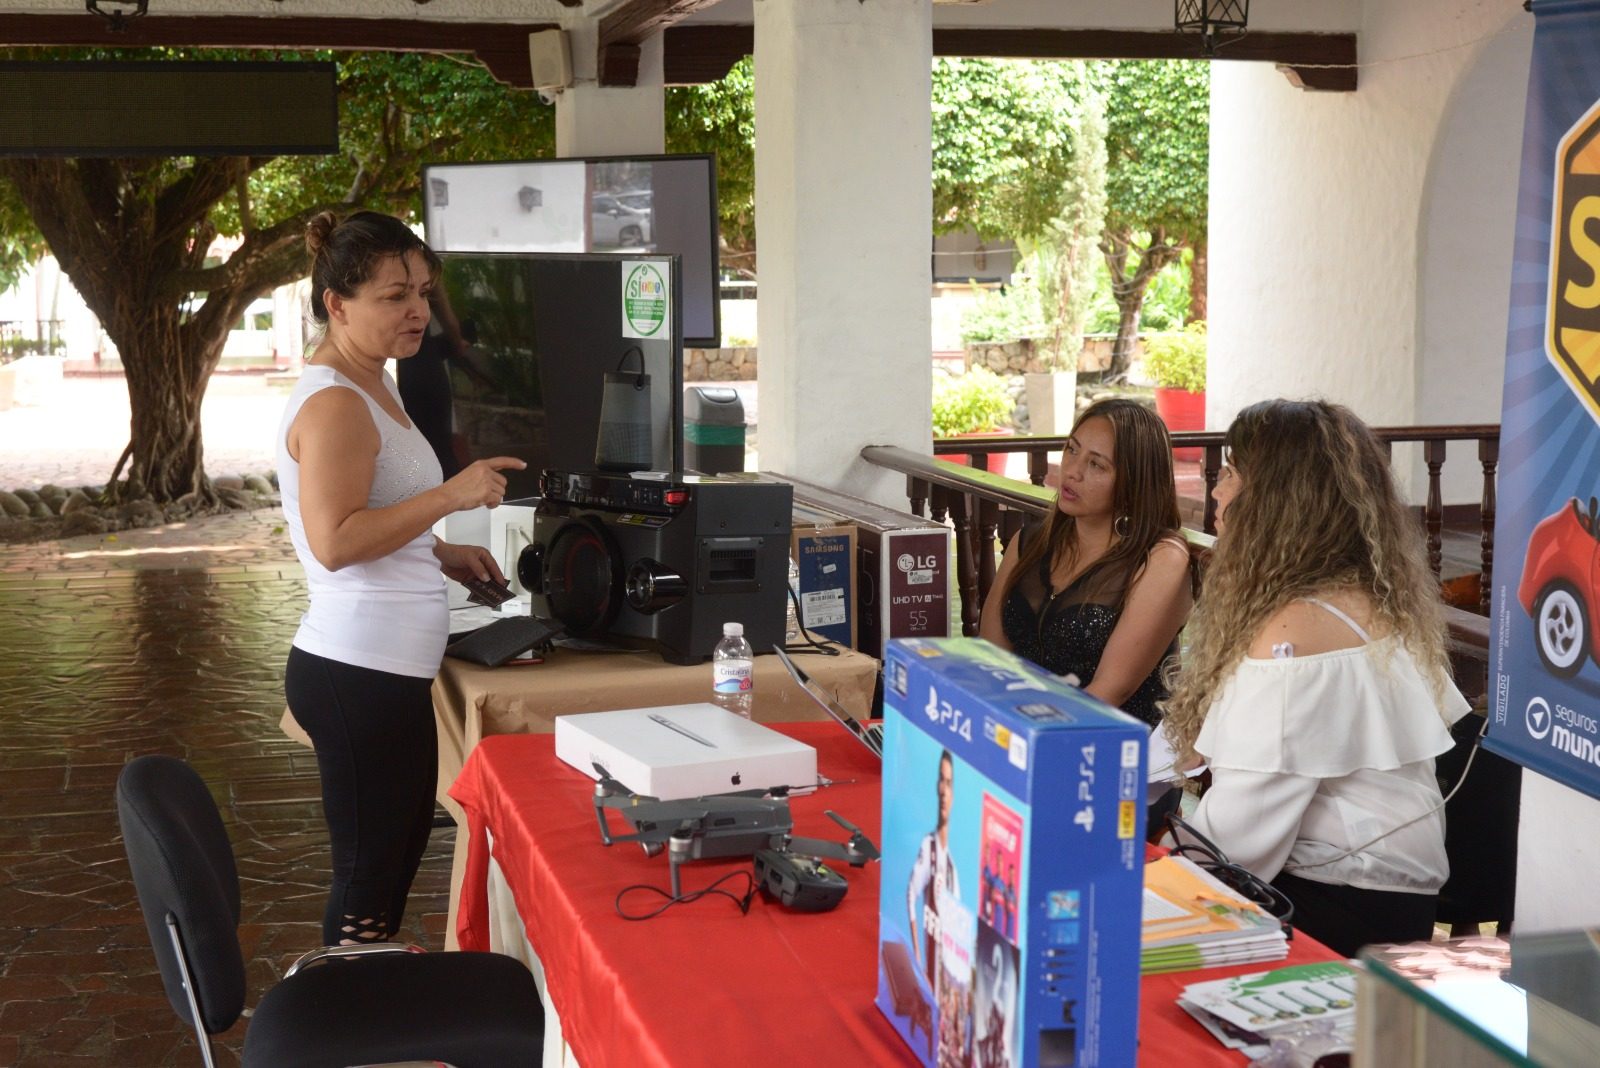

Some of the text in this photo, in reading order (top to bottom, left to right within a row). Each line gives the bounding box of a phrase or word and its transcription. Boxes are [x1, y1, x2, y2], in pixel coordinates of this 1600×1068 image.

[804, 544, 845, 554] SAMSUNG
[917, 555, 937, 569] LG
[892, 596, 911, 605] UHD
[911, 595, 923, 604] TV
[909, 610, 928, 627] 55
[1498, 675, 1507, 722] VIGILADO
[940, 701, 973, 743] PS4
[1555, 704, 1598, 734] seguros
[1078, 744, 1096, 802] PS4
